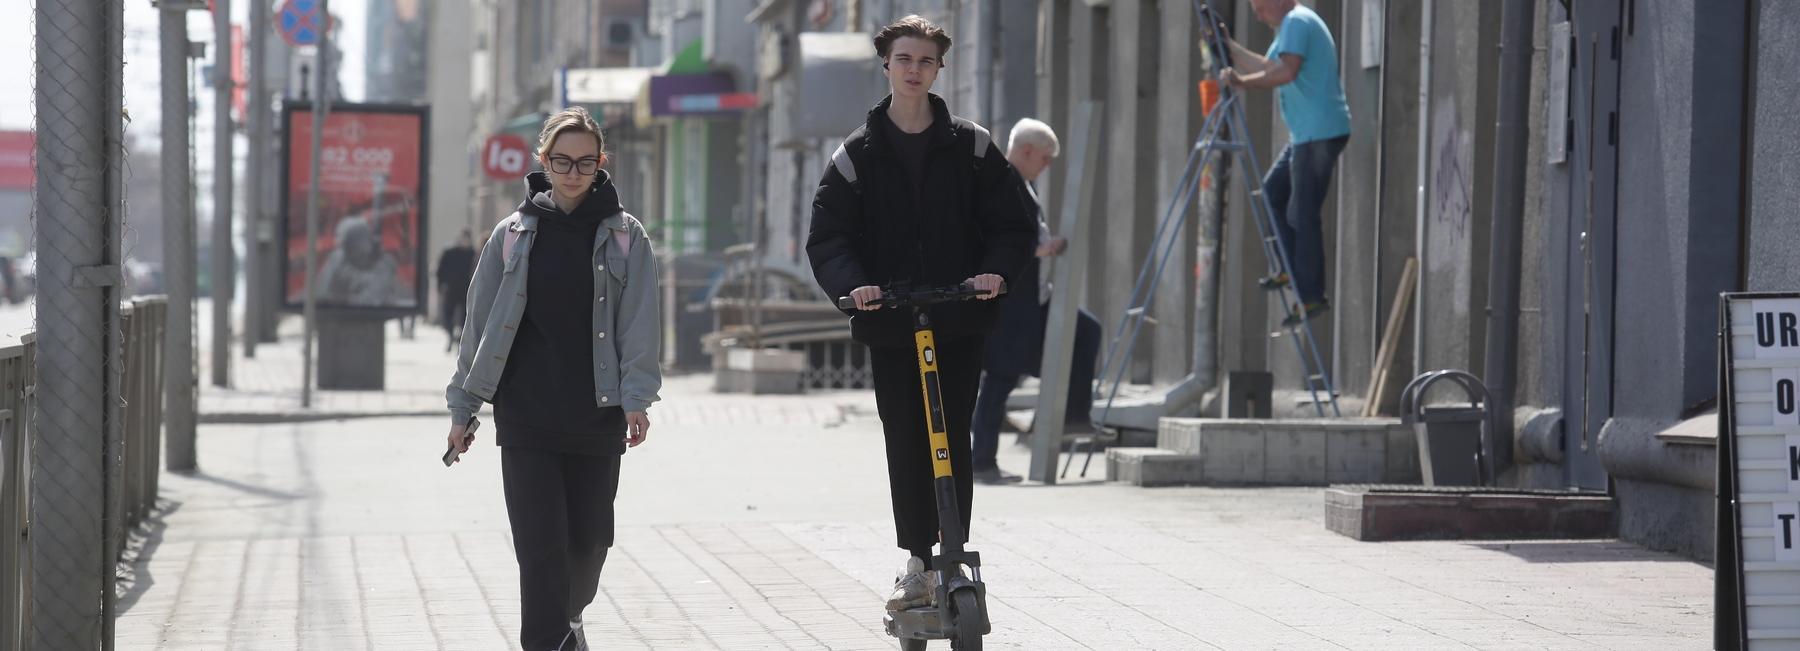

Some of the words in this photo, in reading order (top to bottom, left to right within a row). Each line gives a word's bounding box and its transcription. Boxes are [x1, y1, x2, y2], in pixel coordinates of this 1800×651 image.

[1756, 312, 1799, 347] UR
[1777, 379, 1794, 414] O
[1777, 514, 1795, 549] T
